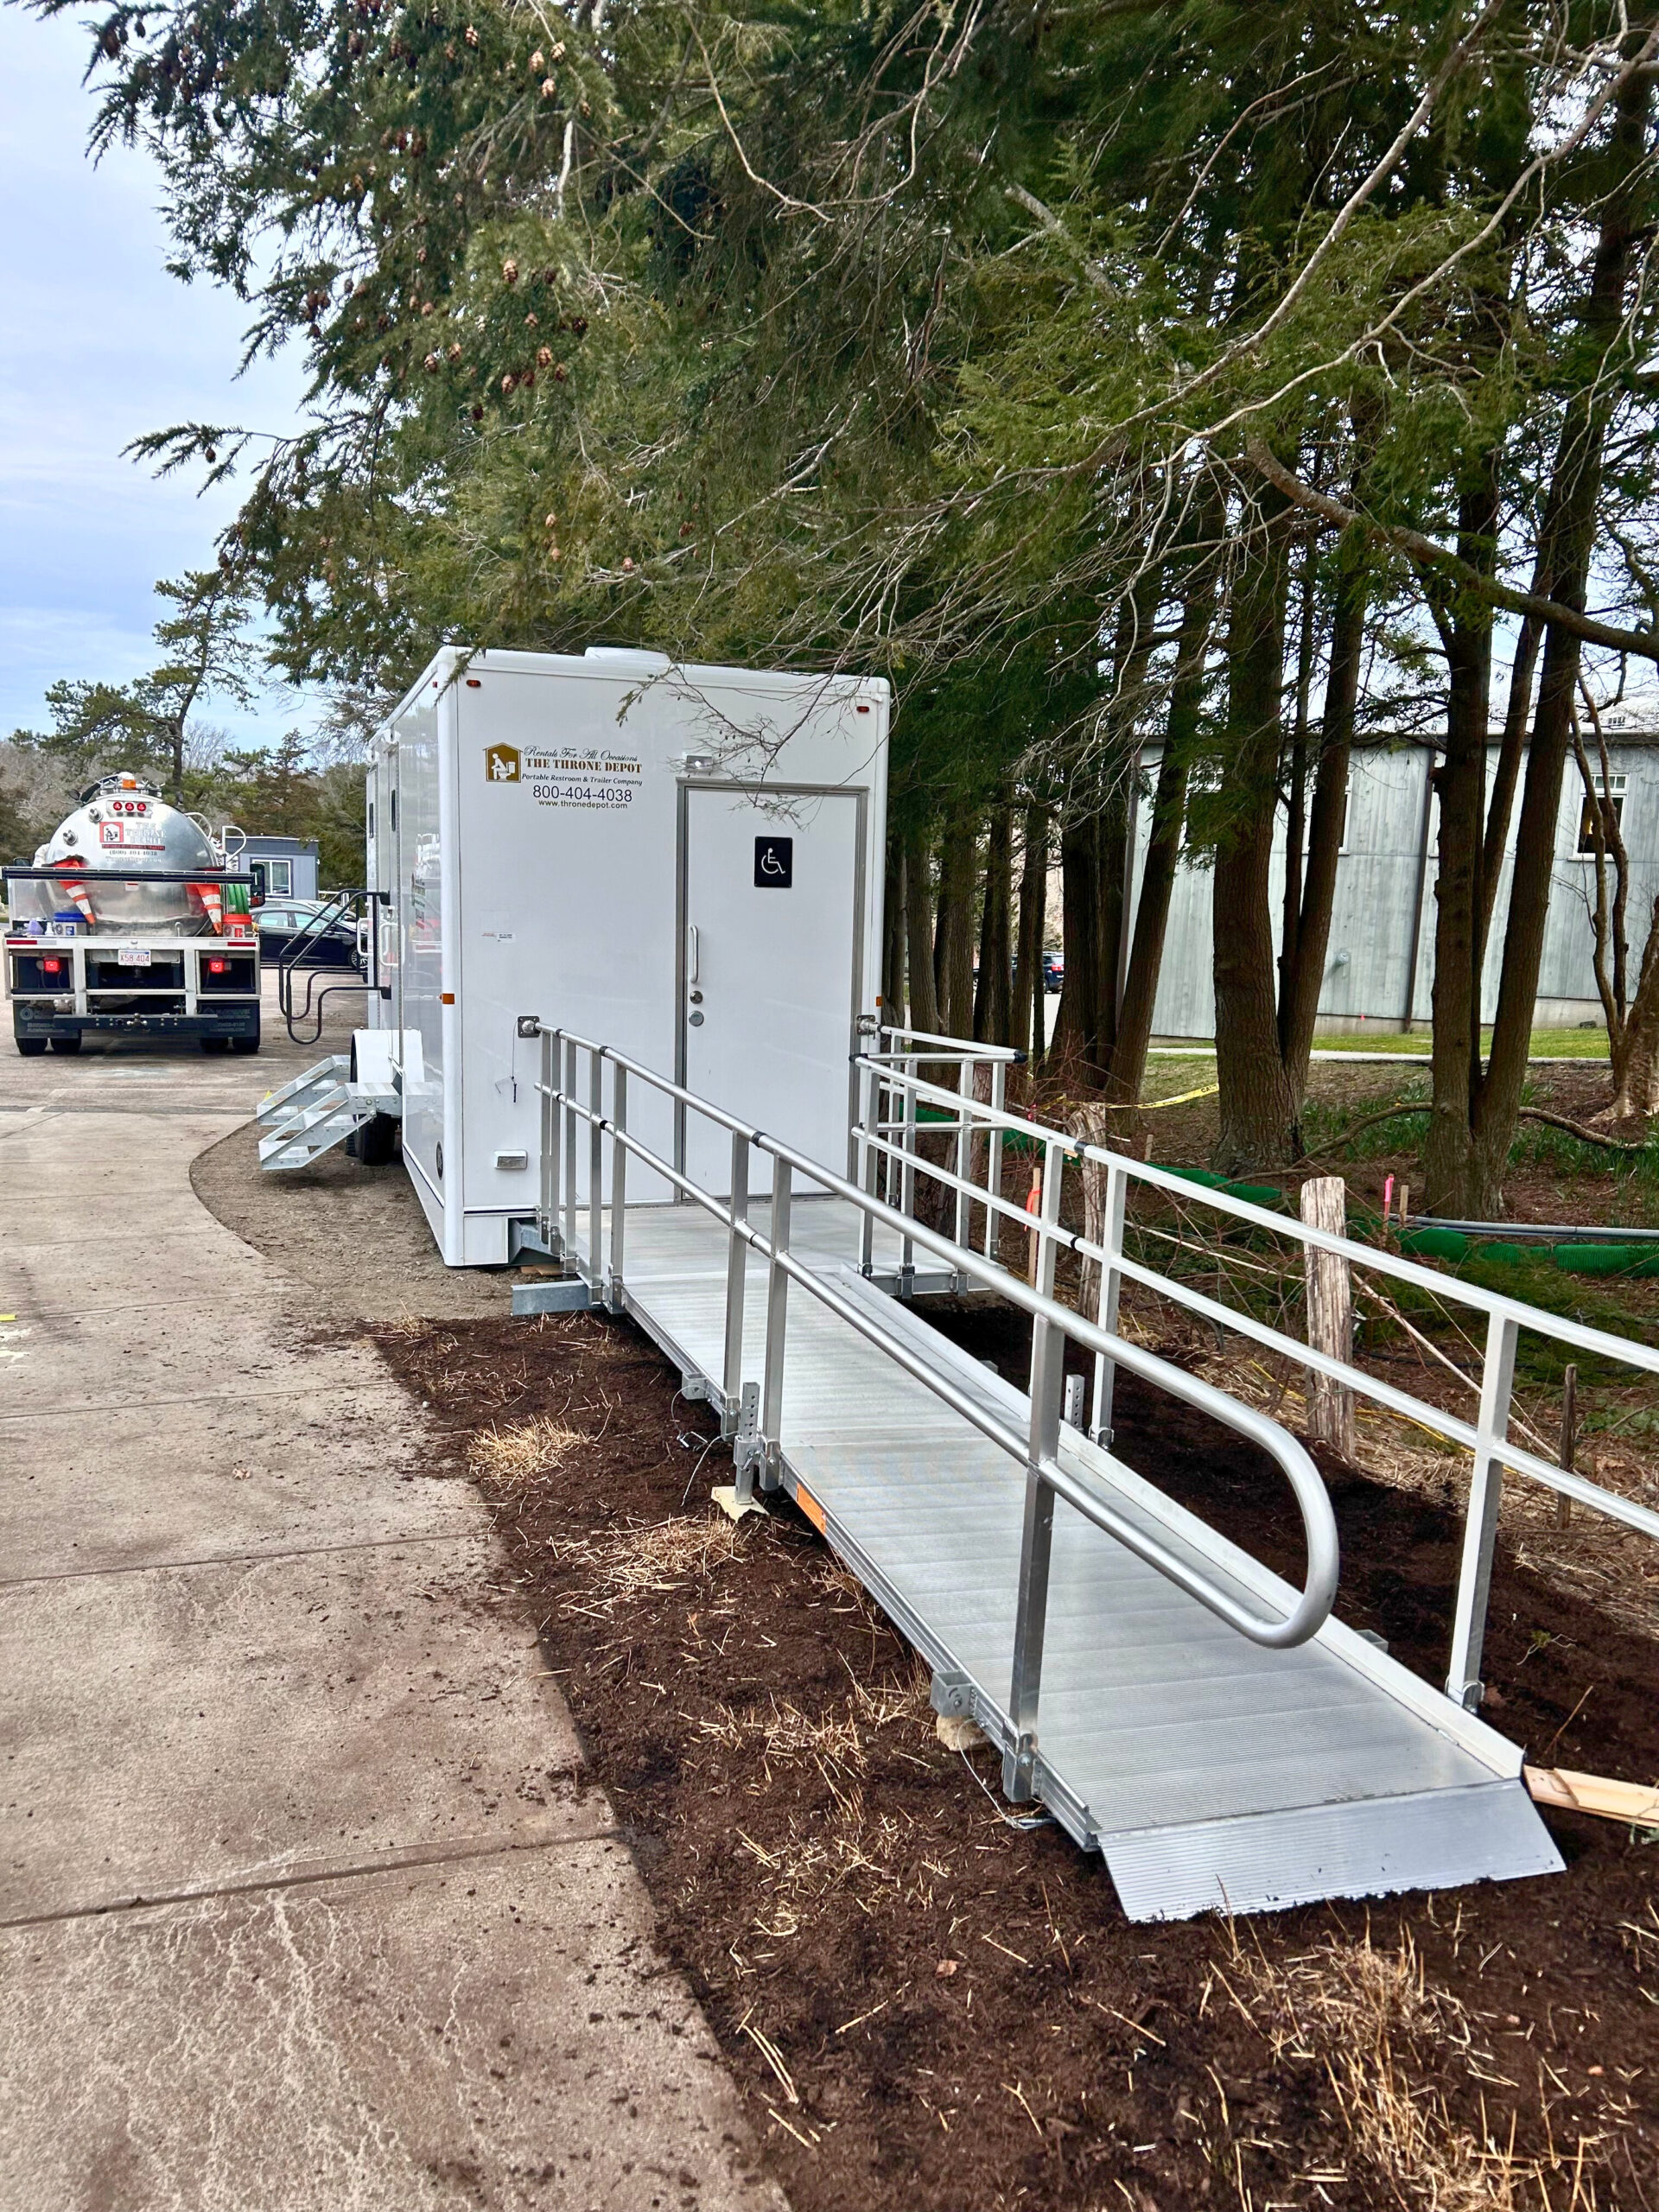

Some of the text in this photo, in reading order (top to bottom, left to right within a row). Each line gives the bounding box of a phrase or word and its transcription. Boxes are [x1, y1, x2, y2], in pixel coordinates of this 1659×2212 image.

[524, 745, 638, 761] Rentals For All Occasions
[525, 758, 642, 773] THE THRONE DEPOT
[550, 774, 582, 783] Restroom
[613, 777, 643, 787] Company
[532, 785, 632, 803] 800-404-4038
[538, 799, 628, 810] www.thronedepot.com
